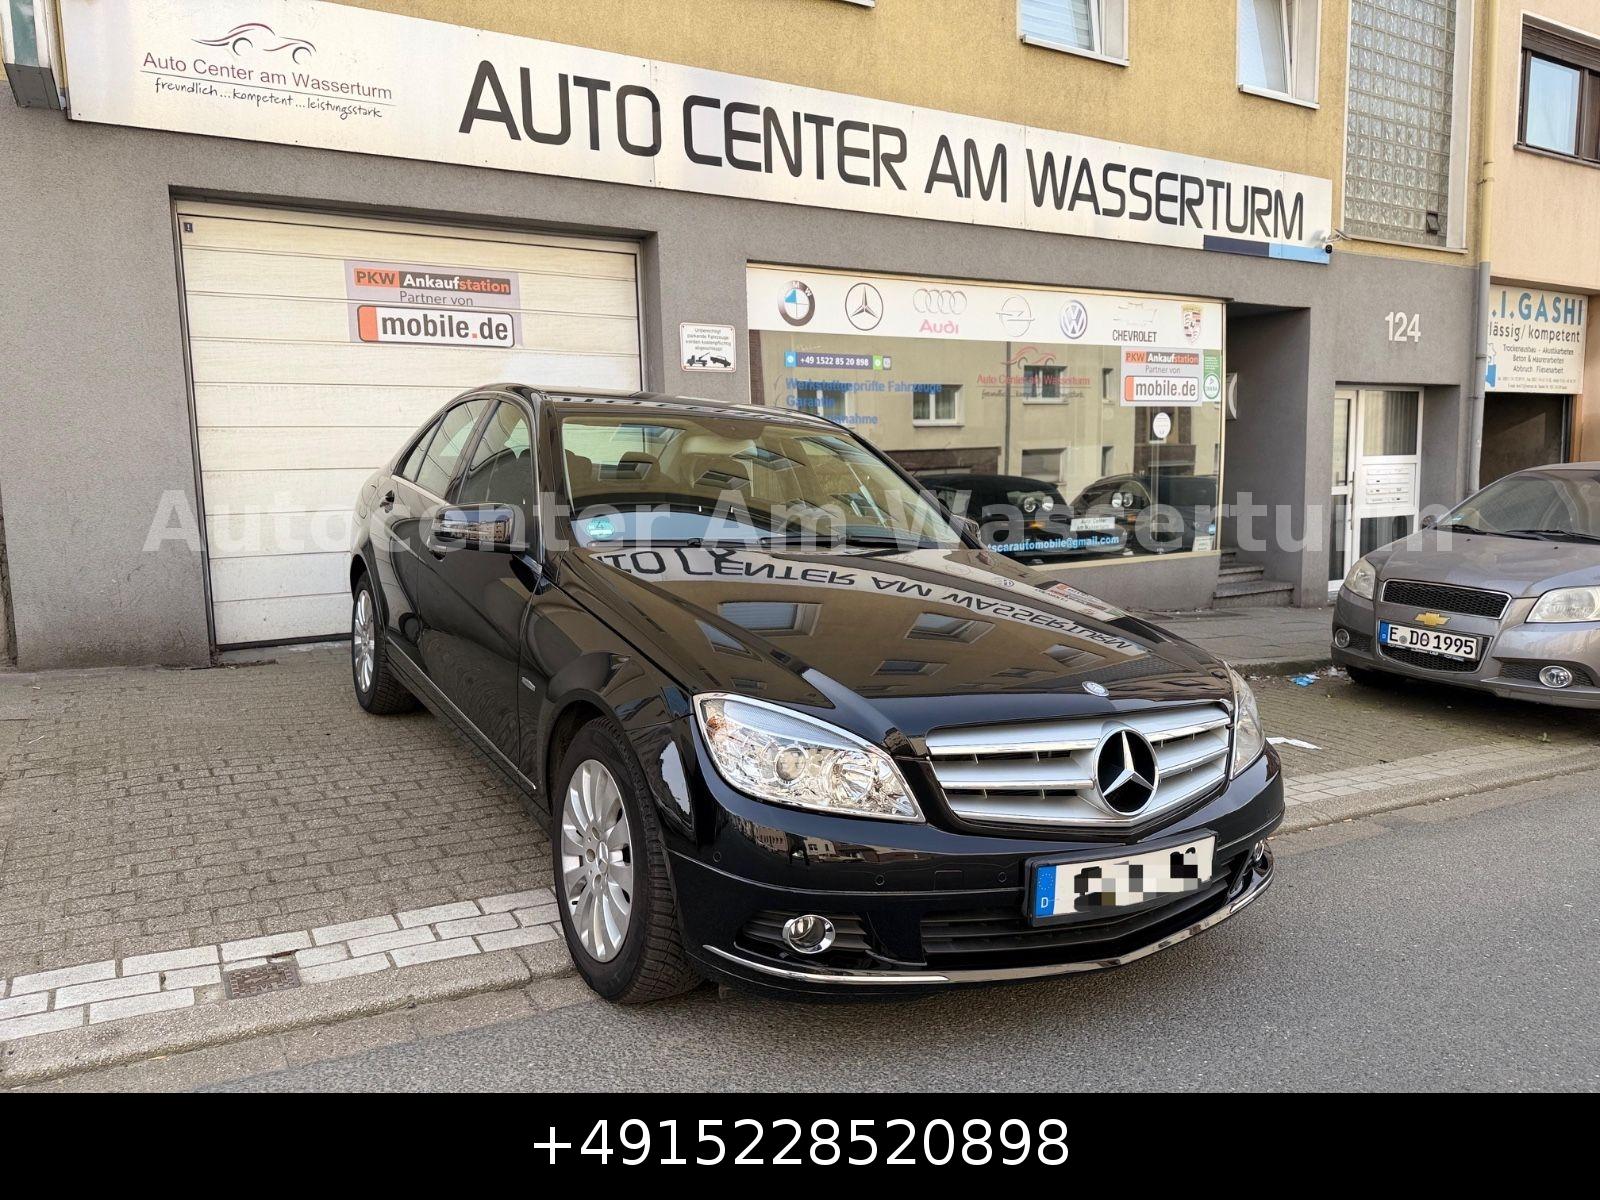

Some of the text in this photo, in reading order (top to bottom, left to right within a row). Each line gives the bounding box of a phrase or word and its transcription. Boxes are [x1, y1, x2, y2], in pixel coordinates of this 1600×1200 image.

[143, 52, 393, 101] Auto Center am Wasserturm
[458, 60, 1304, 241] AUTO CENTER AM WASSERTURM
[356, 270, 511, 295] PKW Ankaufstation
[399, 290, 474, 307] Partner von
[381, 313, 509, 342] mobile.de
[919, 319, 959, 335] Audi
[1384, 311, 1421, 343] 124
[1488, 322, 1580, 344] lässig/ kompetent
[1112, 329, 1158, 343] CHEVROLET
[800, 356, 869, 367] +49 1522 85 20 898
[1126, 352, 1146, 363] PKW
[1147, 352, 1199, 365] Ankaufstation
[1145, 364, 1168, 374] Partner
[887, 380, 943, 394] Fahrzeuge
[977, 374, 996, 385] Auto
[1135, 379, 1196, 397] mobile.de
[787, 395, 836, 408] Garantie
[1432, 635, 1475, 655] 1995
[1040, 896, 1049, 908] D
